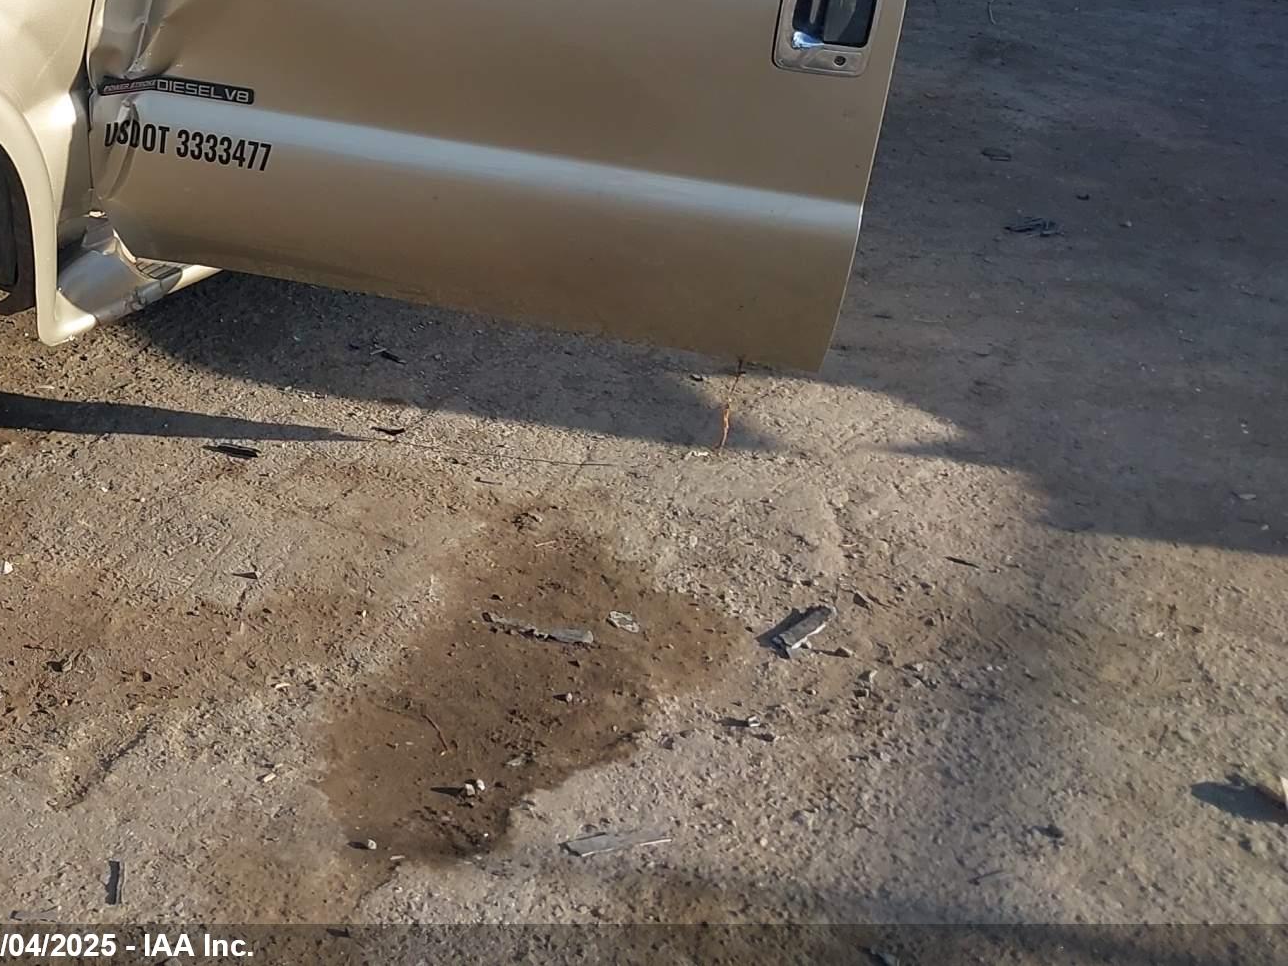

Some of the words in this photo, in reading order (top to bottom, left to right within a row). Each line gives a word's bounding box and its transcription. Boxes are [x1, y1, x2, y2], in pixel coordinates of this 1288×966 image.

[157, 79, 223, 99] DIESEL
[224, 88, 249, 103] V8
[104, 119, 171, 154] USDOT
[176, 129, 272, 172] 3333477
